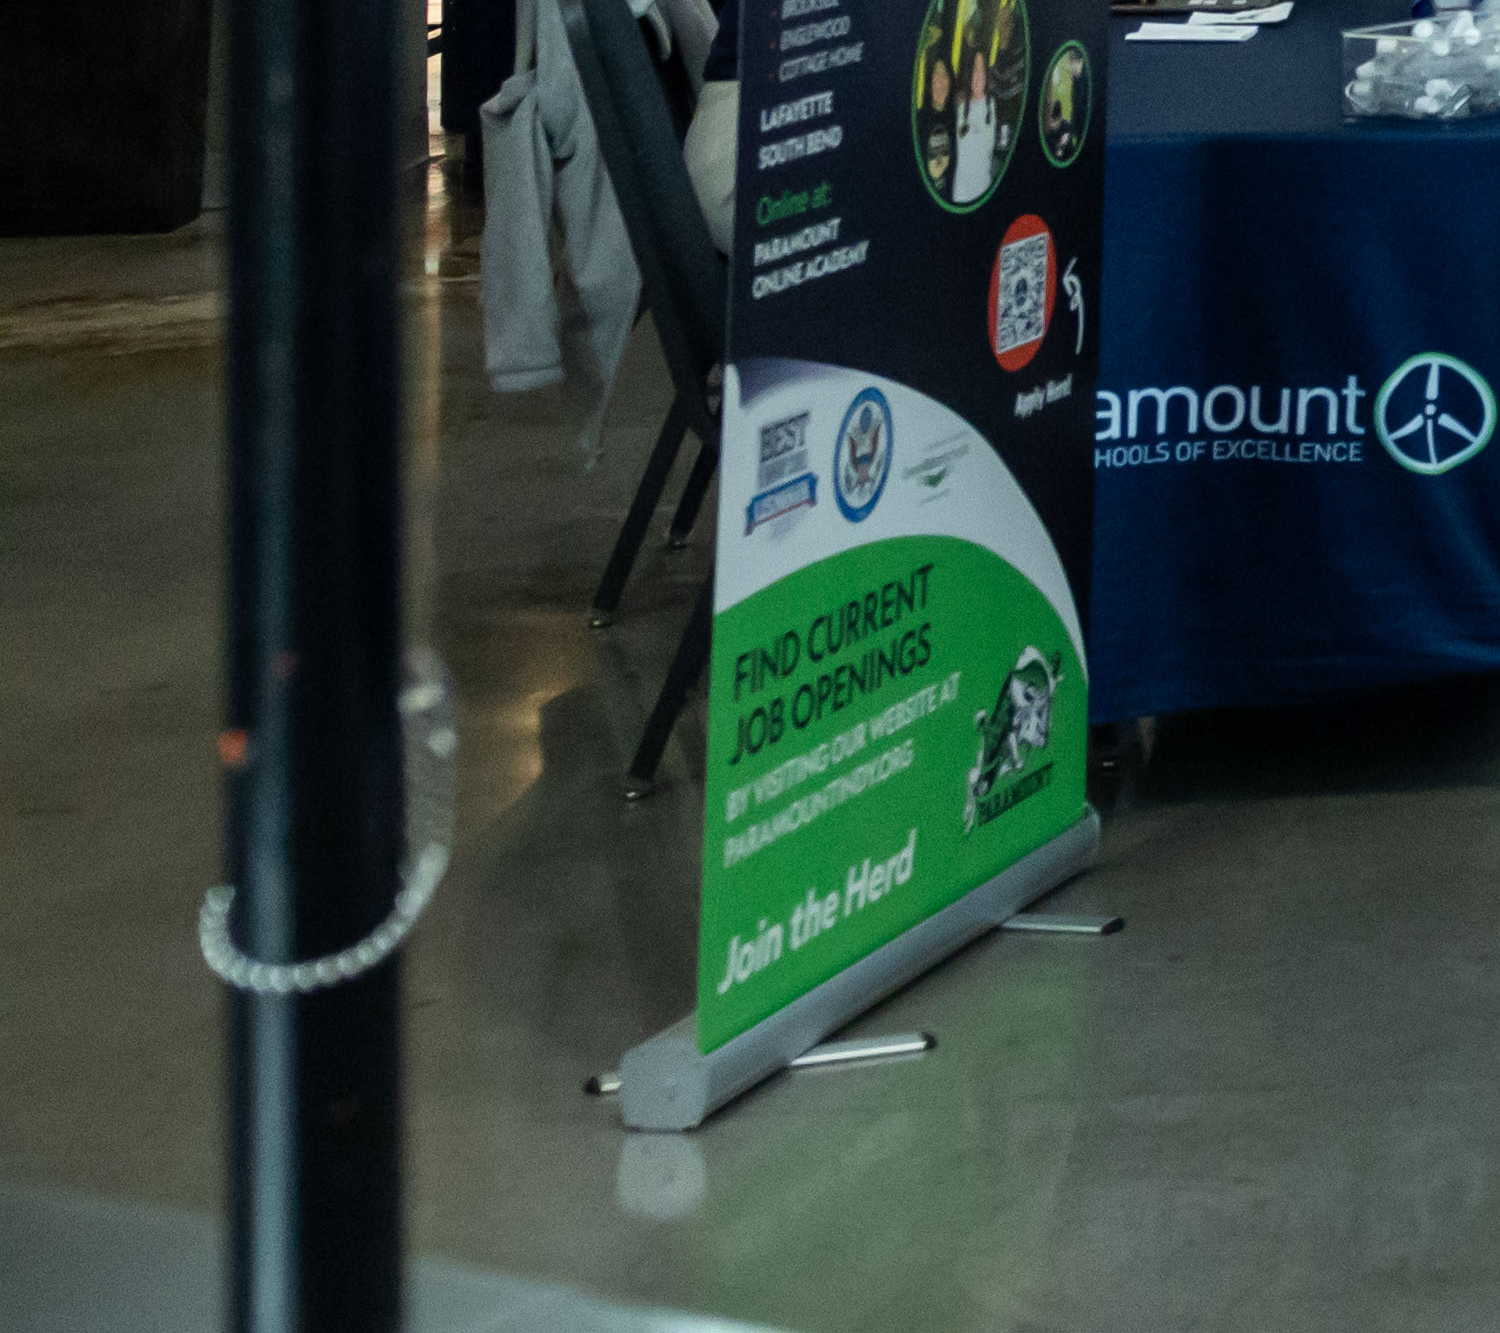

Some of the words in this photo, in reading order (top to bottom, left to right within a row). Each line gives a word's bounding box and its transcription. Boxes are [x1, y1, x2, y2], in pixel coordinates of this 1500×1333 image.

[760, 89, 834, 133] LAFAYETTE
[1095, 375, 1366, 441] amount
[1175, 441, 1206, 463] OF
[1212, 440, 1363, 464] EXCELLENCE
[733, 628, 800, 702] FIND
[806, 563, 935, 664] CURRENT
[729, 702, 785, 766] JOB
[790, 621, 932, 731] OPENINGS
[717, 916, 783, 996] Join
[788, 885, 841, 952] the
[843, 828, 918, 916] Herd
